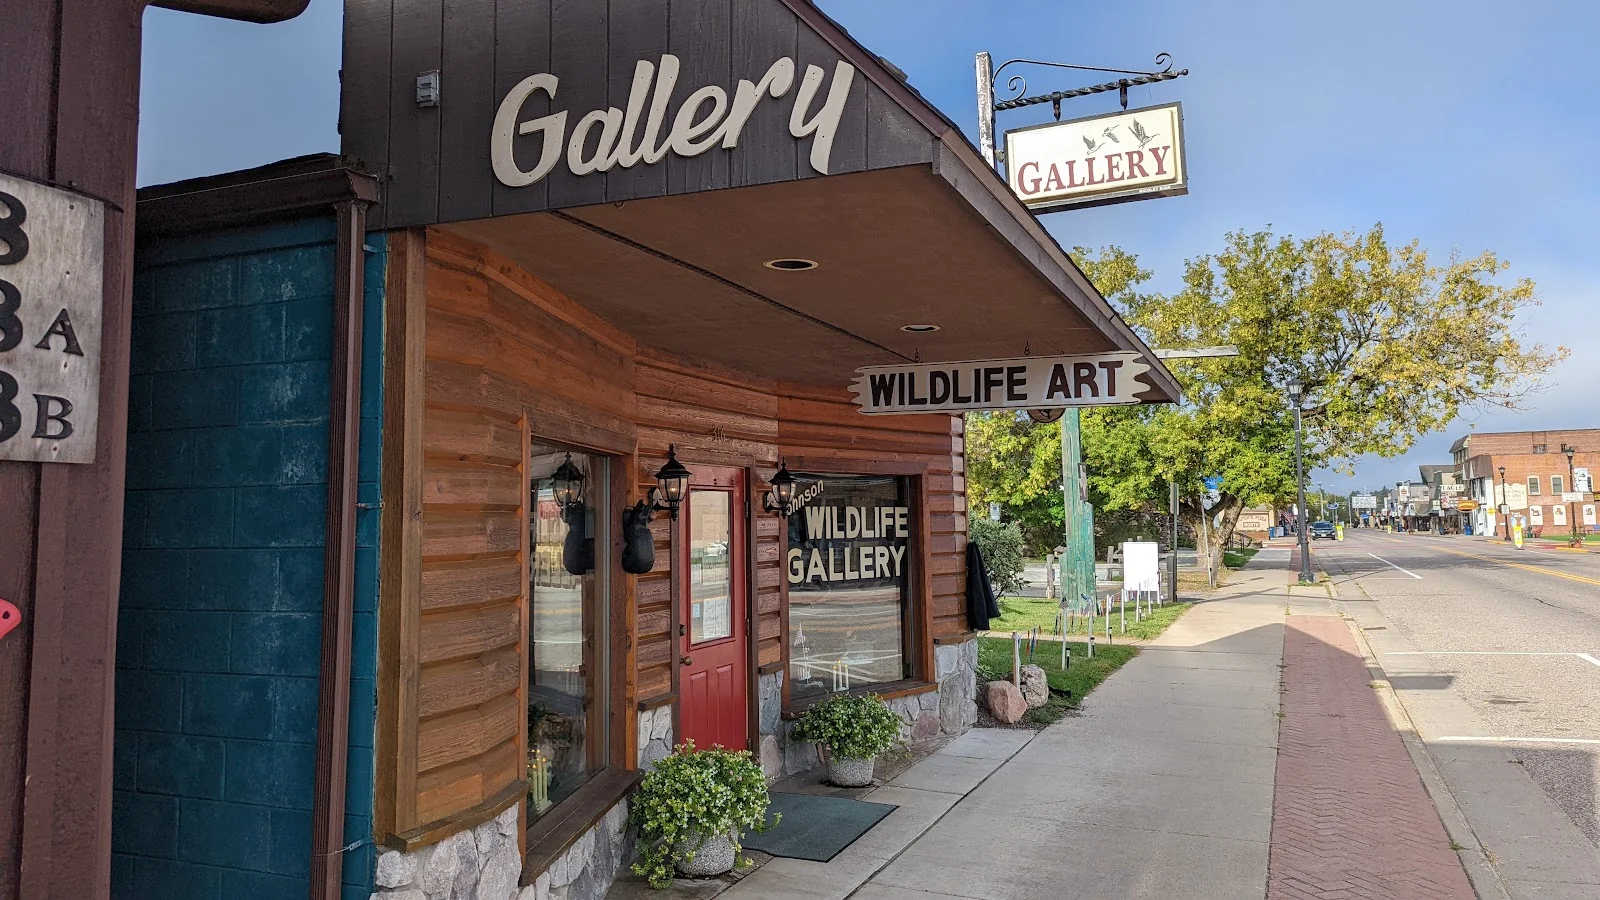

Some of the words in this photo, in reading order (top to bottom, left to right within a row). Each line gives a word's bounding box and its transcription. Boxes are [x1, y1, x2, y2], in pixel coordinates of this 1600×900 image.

[491, 54, 854, 187] Gallery
[1018, 145, 1170, 195] GALLERY
[869, 365, 1027, 407] WILDLIFE
[1046, 360, 1123, 399] ART
[786, 479, 825, 516] ohnson
[805, 506, 908, 539] WILDLIFE
[788, 545, 905, 583] GALLERY
